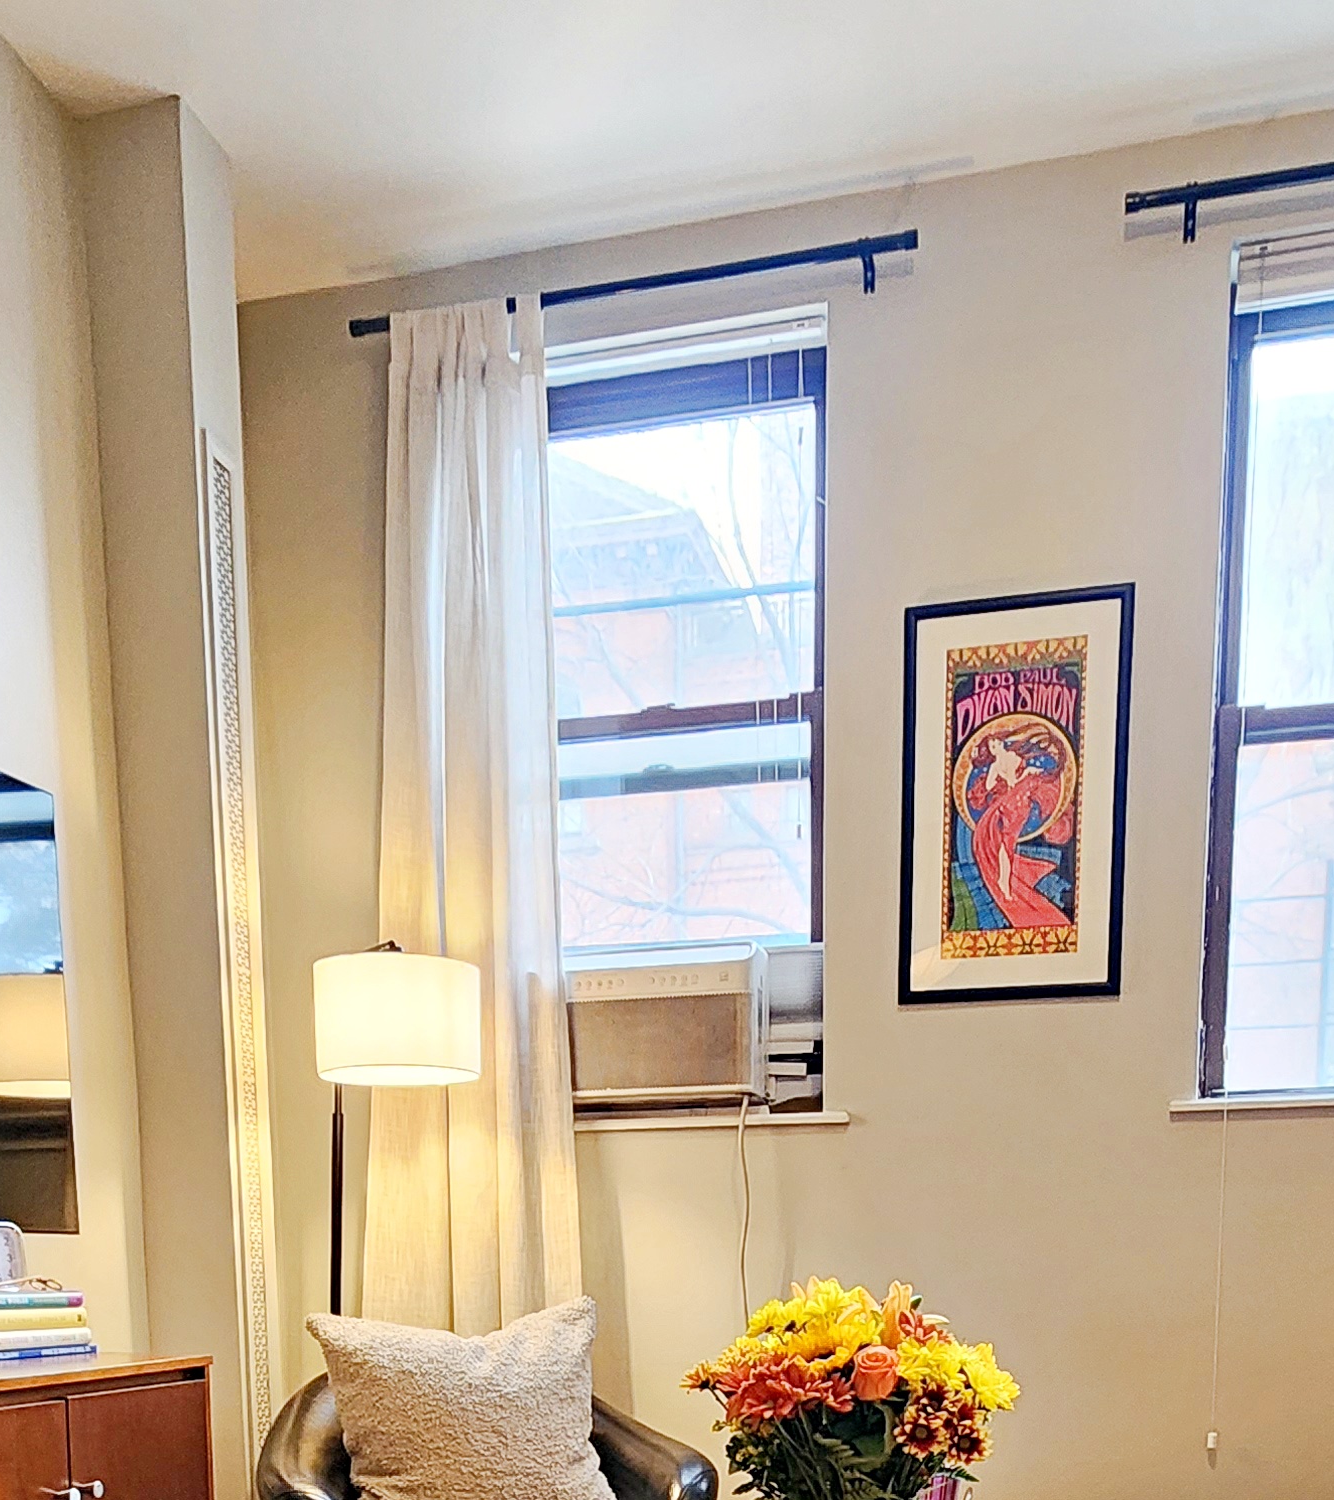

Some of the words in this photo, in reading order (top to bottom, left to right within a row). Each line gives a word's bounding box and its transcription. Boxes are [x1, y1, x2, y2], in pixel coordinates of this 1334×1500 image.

[975, 672, 1014, 692] BOB
[1019, 667, 1066, 684] PAUL
[956, 684, 1015, 746] DYLAN
[1017, 682, 1077, 736] SIMON
[4, 1234, 10, 1246] 2
[7, 1253, 13, 1262] 3
